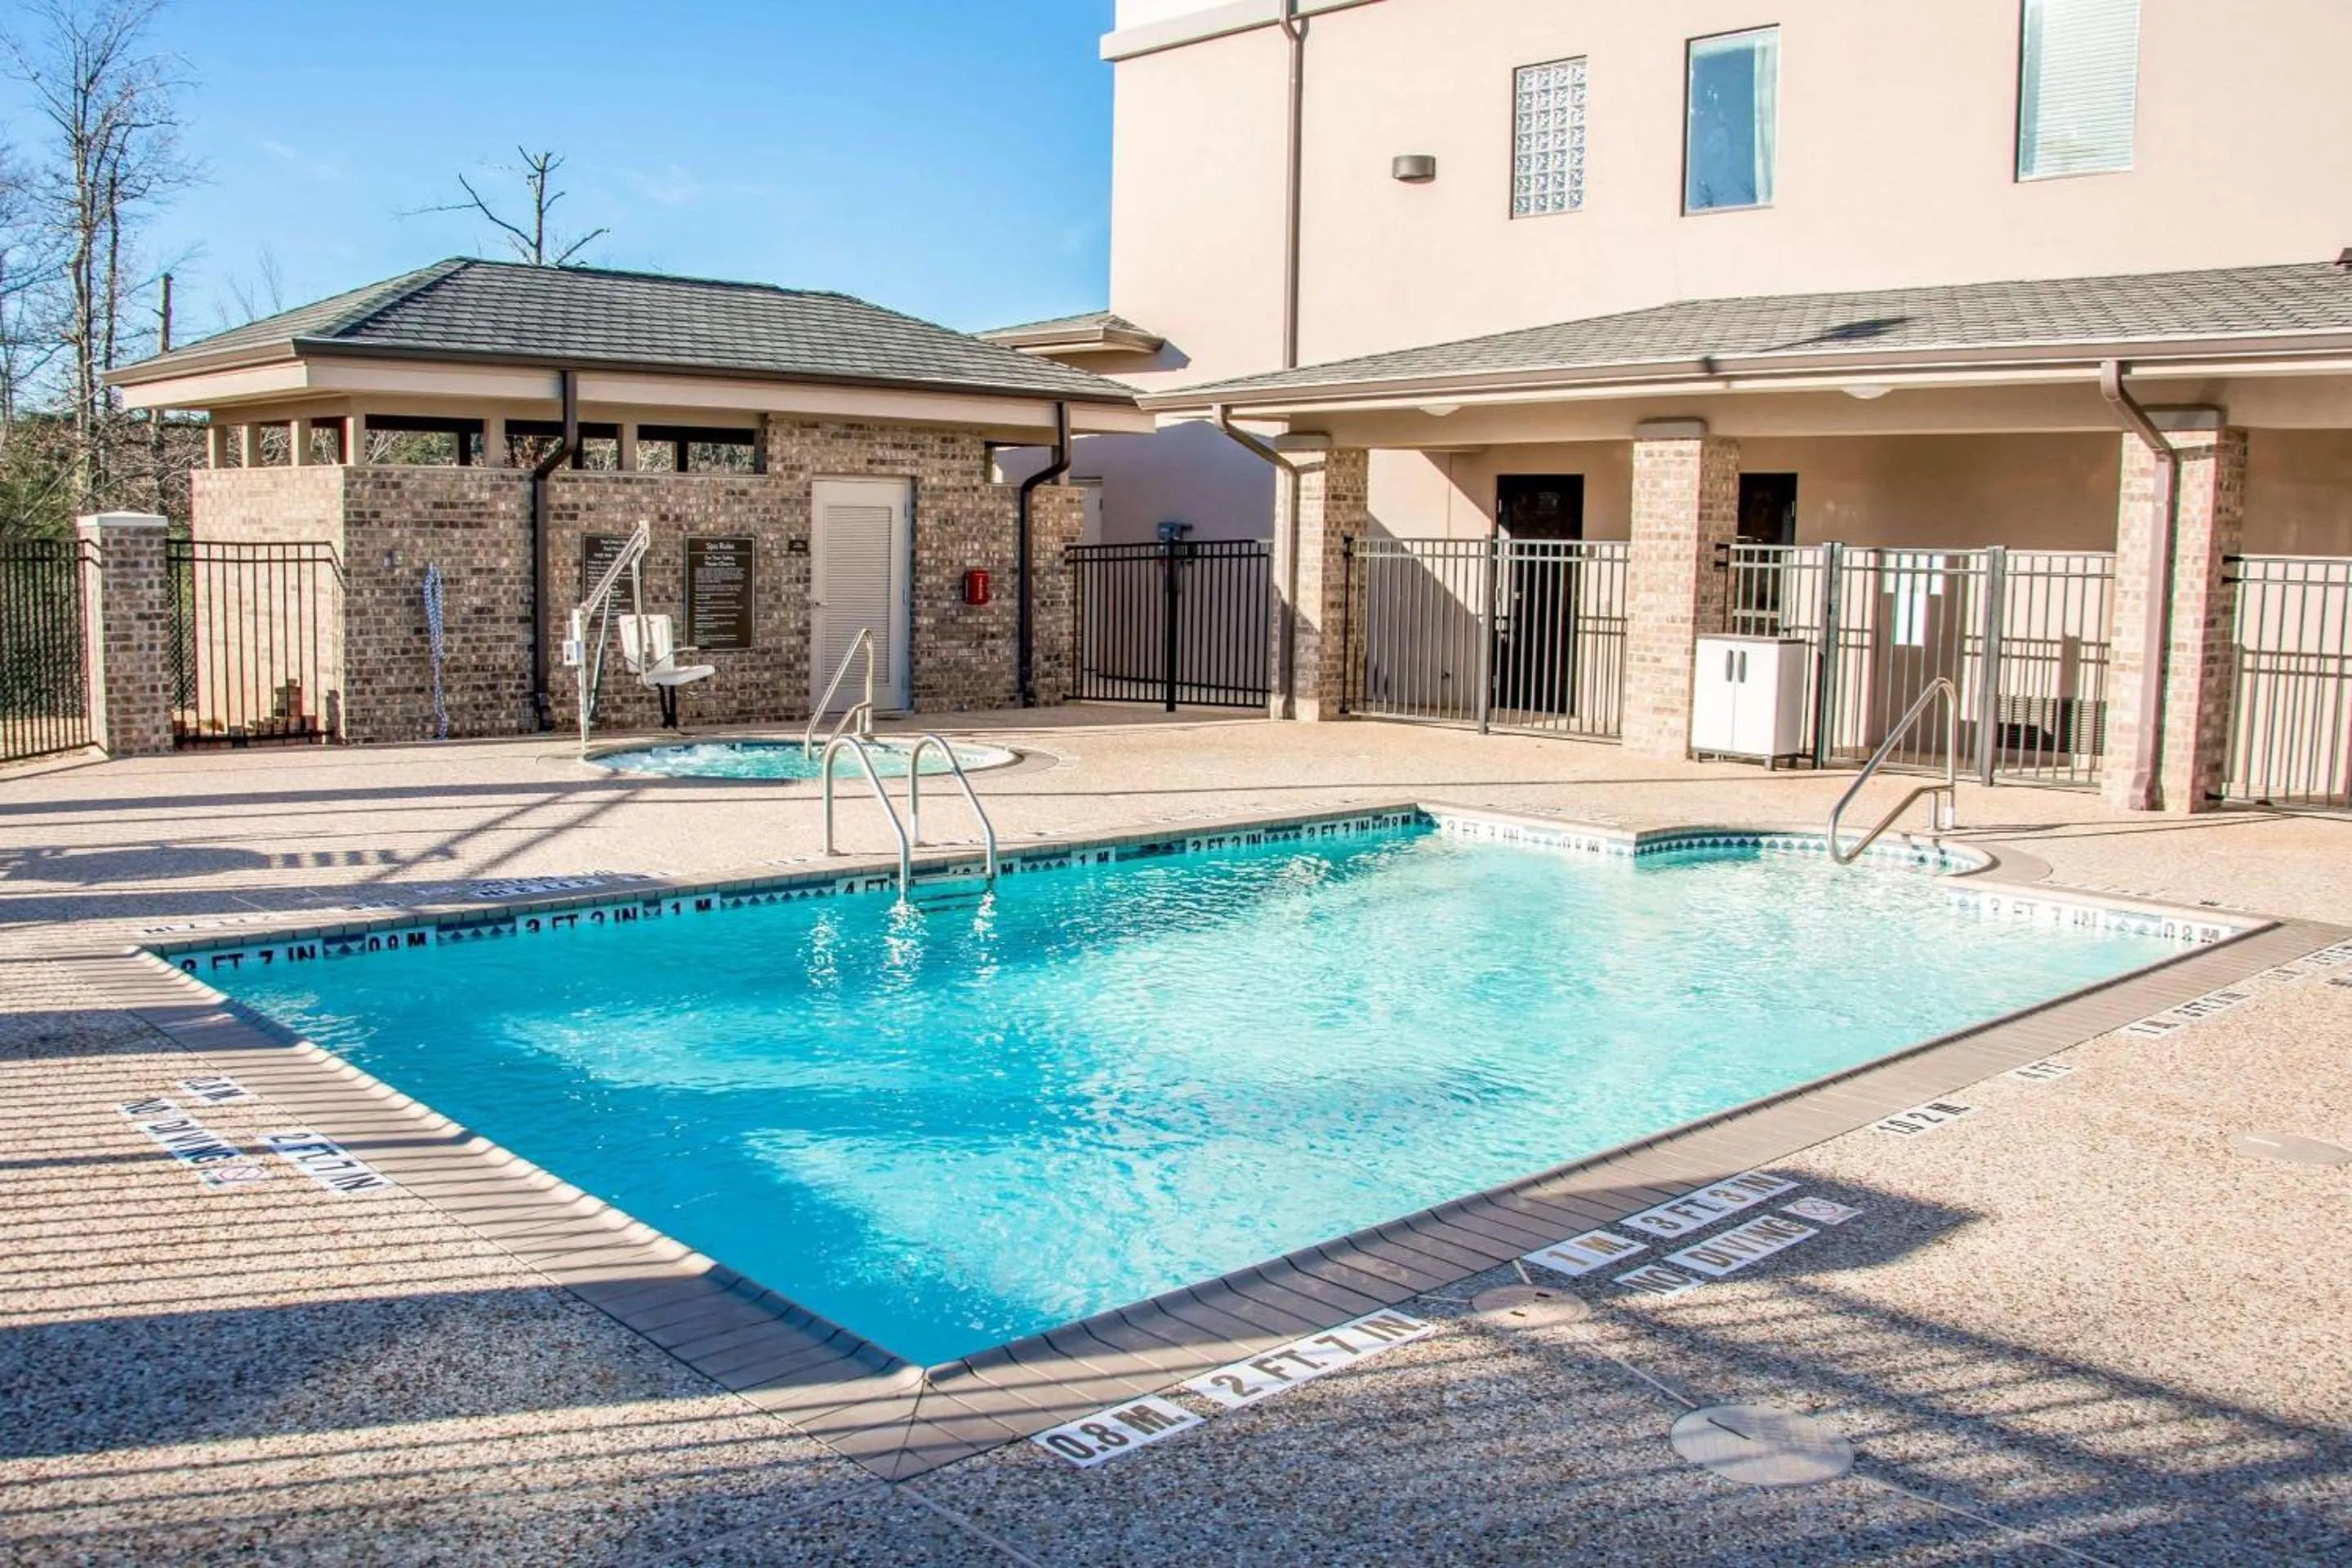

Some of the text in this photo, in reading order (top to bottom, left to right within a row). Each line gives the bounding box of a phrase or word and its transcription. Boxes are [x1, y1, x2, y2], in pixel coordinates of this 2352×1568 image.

[865, 878, 888, 892] FT
[551, 913, 579, 930] FT
[614, 906, 637, 924] IN
[212, 952, 244, 970] FT
[288, 944, 316, 961] IN
[148, 1119, 236, 1163] DIVING
[1547, 1250, 1590, 1266] 1
[1641, 1216, 1682, 1231] 3
[1665, 1197, 1725, 1220] FT.
[1708, 1188, 1748, 1202] 3
[1623, 1218, 1808, 1296] NO DIVING
[1045, 1313, 1428, 1459] 0.8 M. 2 FT. 7 IN.
